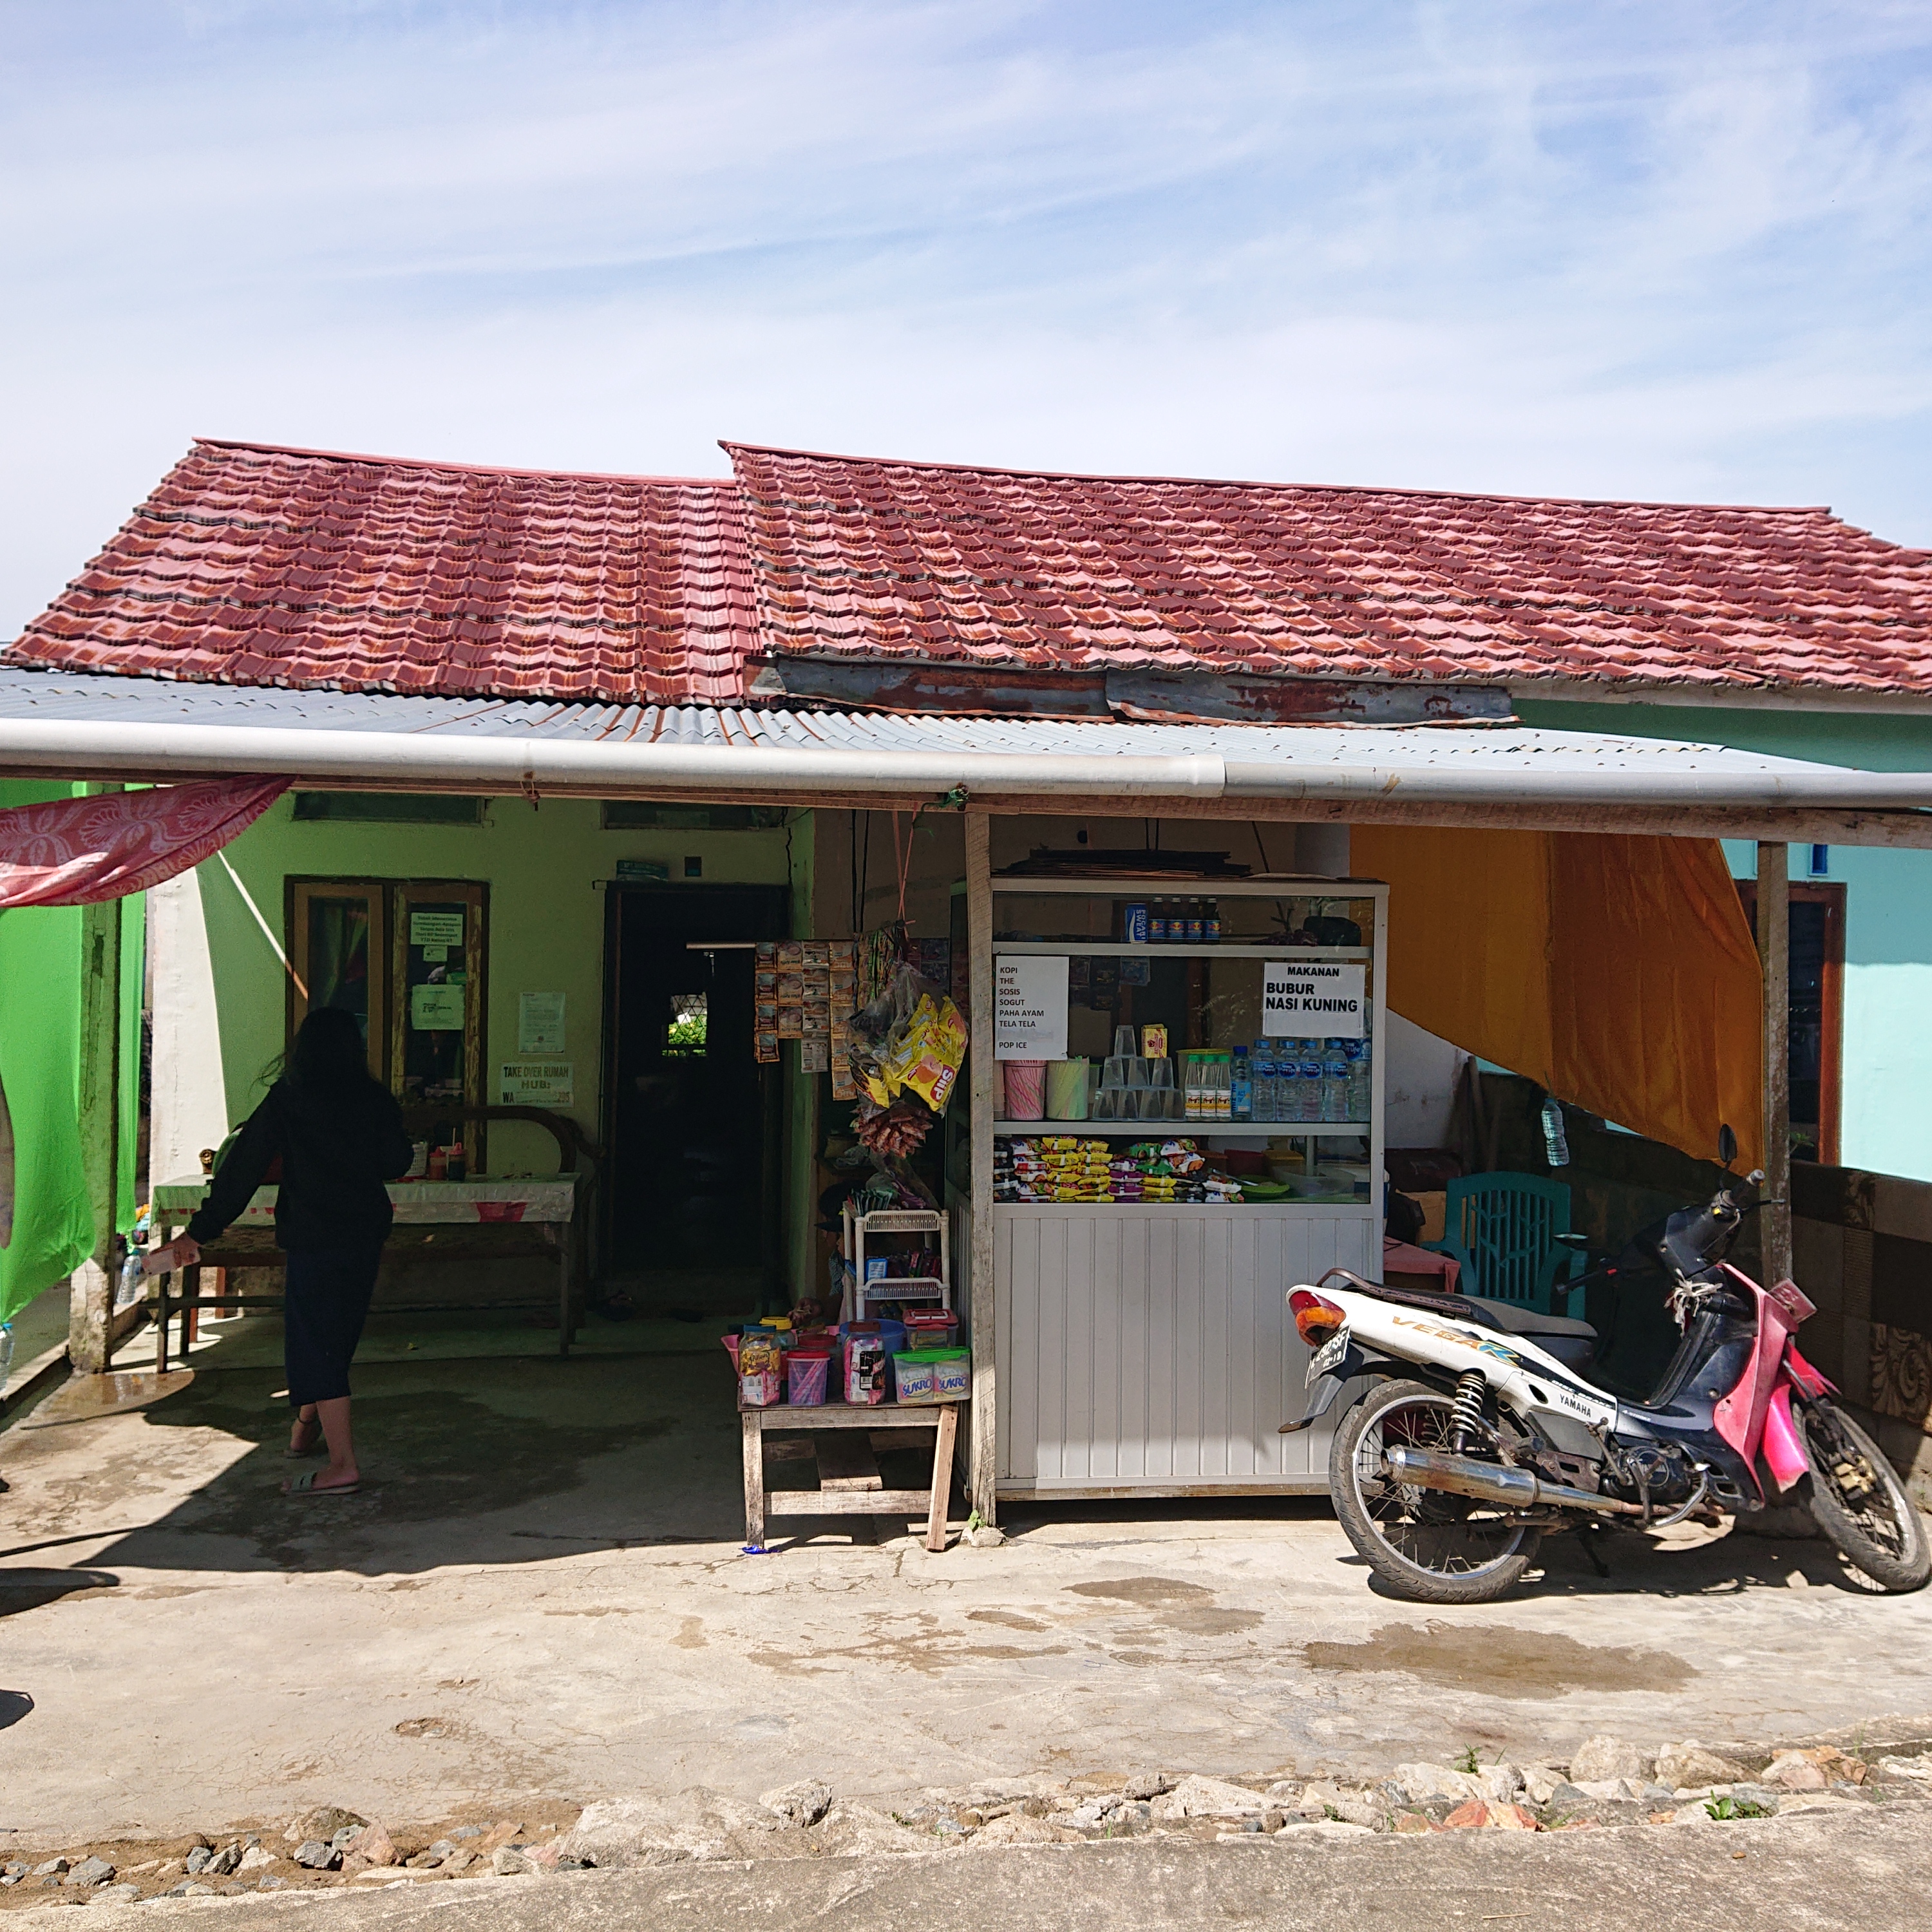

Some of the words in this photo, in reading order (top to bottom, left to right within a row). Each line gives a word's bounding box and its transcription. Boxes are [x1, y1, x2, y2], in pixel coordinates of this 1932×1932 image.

[1287, 967, 1340, 977] MAKANAN
[1266, 983, 1315, 994] BUBUR
[1266, 997, 1298, 1010] NASI
[1302, 998, 1358, 1012] KUNING
[504, 1066, 522, 1077] TAKE
[524, 1066, 542, 1077] OVER
[544, 1066, 569, 1078] RUMAH
[522, 1079, 551, 1089] HUB:
[502, 1092, 514, 1103] WA
[1392, 1316, 1481, 1351] VEGA
[1477, 1340, 1520, 1368] R
[903, 1378, 933, 1396] SUKRO
[938, 1377, 967, 1390] SUKRO
[1552, 1379, 1577, 1394] DISC
[1560, 1394, 1591, 1418] YAMAHA
